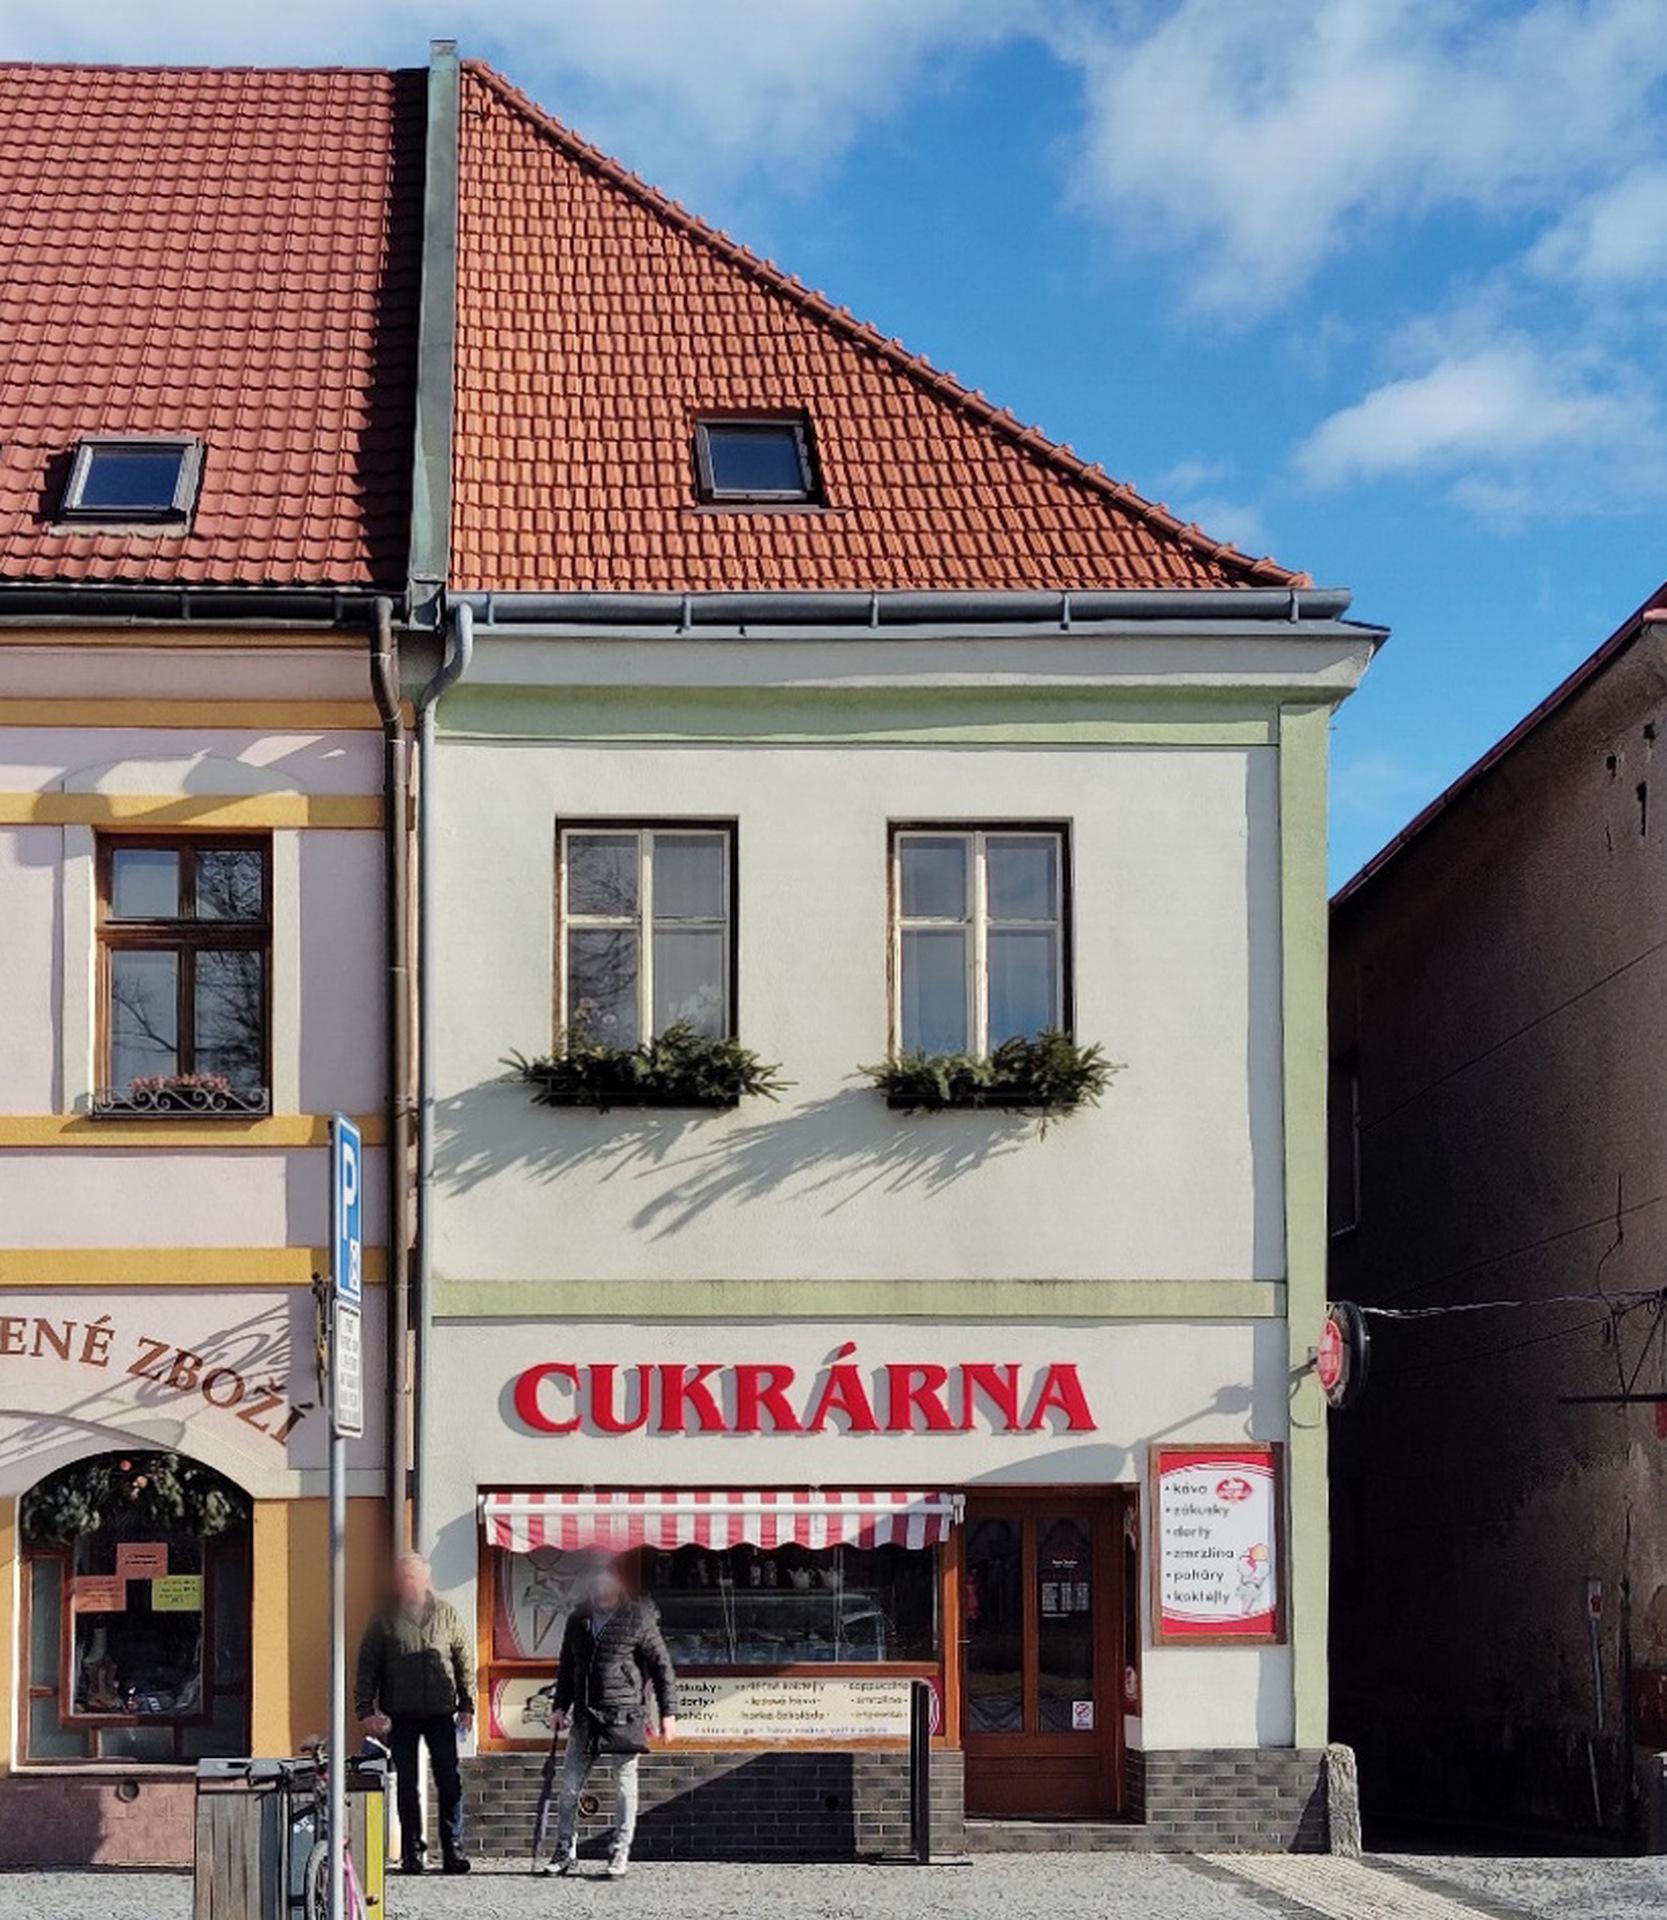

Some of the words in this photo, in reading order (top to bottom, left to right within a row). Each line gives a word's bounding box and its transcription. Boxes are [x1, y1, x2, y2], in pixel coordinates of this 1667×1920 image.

[341, 1142, 357, 1239] P
[126, 1336, 315, 1446] ZBOŽÍ
[512, 1341, 1100, 1433] CUKRÁRNA
[1173, 1482, 1208, 1494] káva
[1173, 1504, 1229, 1518] zákusky
[1173, 1525, 1212, 1539] dorty
[1173, 1546, 1235, 1559] zmrzlina
[1173, 1568, 1224, 1583] poháry
[1173, 1591, 1230, 1605] koktejly
